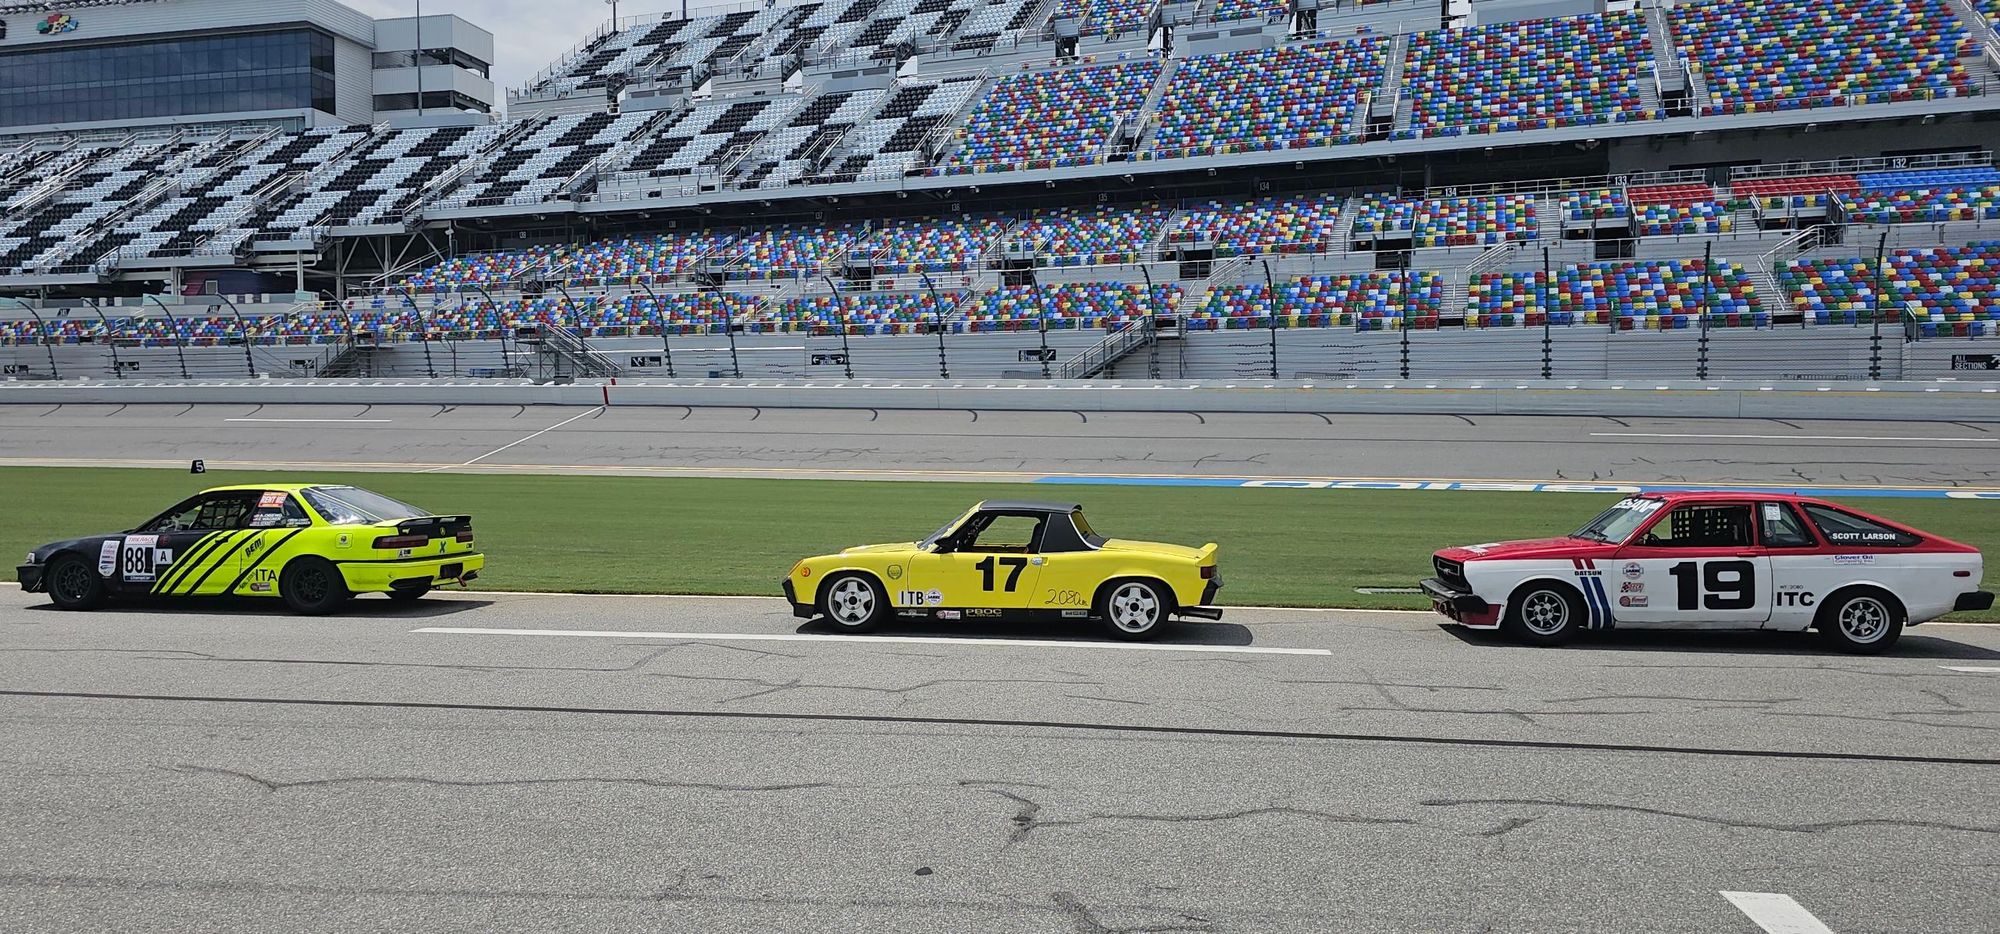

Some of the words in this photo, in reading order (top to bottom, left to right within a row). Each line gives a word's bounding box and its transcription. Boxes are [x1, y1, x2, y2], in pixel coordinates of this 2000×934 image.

[1892, 157, 1906, 168] 132
[1615, 175, 1627, 185] 133
[1445, 187, 1456, 196] 134
[1955, 355, 1967, 363] ALL
[1955, 362, 1987, 370] SECTIONS
[195, 461, 203, 472] 5
[160, 551, 167, 562] A
[255, 568, 277, 581] ITA
[975, 556, 1028, 592] 17
[1669, 561, 1755, 610] 19
[1776, 592, 1815, 606] ITC
